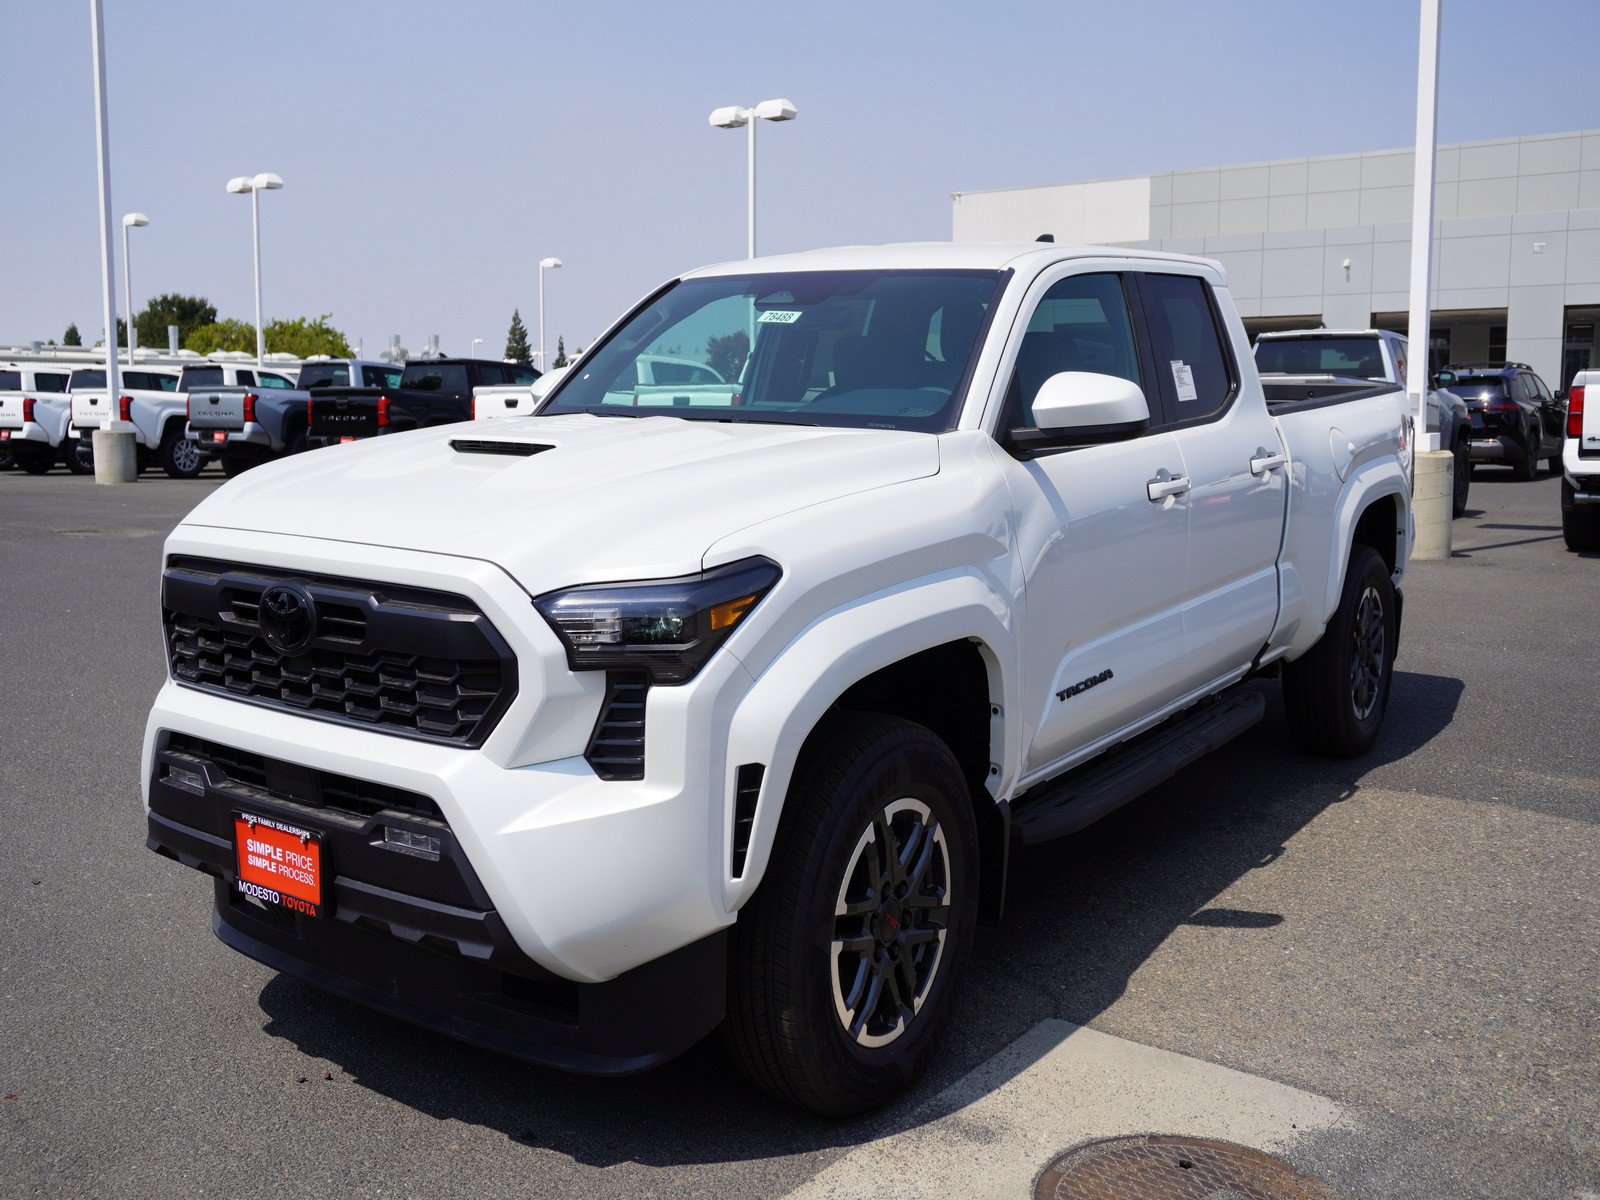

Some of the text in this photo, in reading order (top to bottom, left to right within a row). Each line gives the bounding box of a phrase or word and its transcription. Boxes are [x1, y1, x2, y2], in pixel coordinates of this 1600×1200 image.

[764, 312, 795, 322] 78488
[1056, 668, 1114, 702] TACOMA
[241, 813, 311, 839] PRICE FAMILY DEALERSHIPS
[246, 839, 316, 873] SIMPLE PRICE.
[247, 854, 316, 887] SIMPLE PROCESS.
[238, 880, 316, 917] MODESTO TOYOTA
